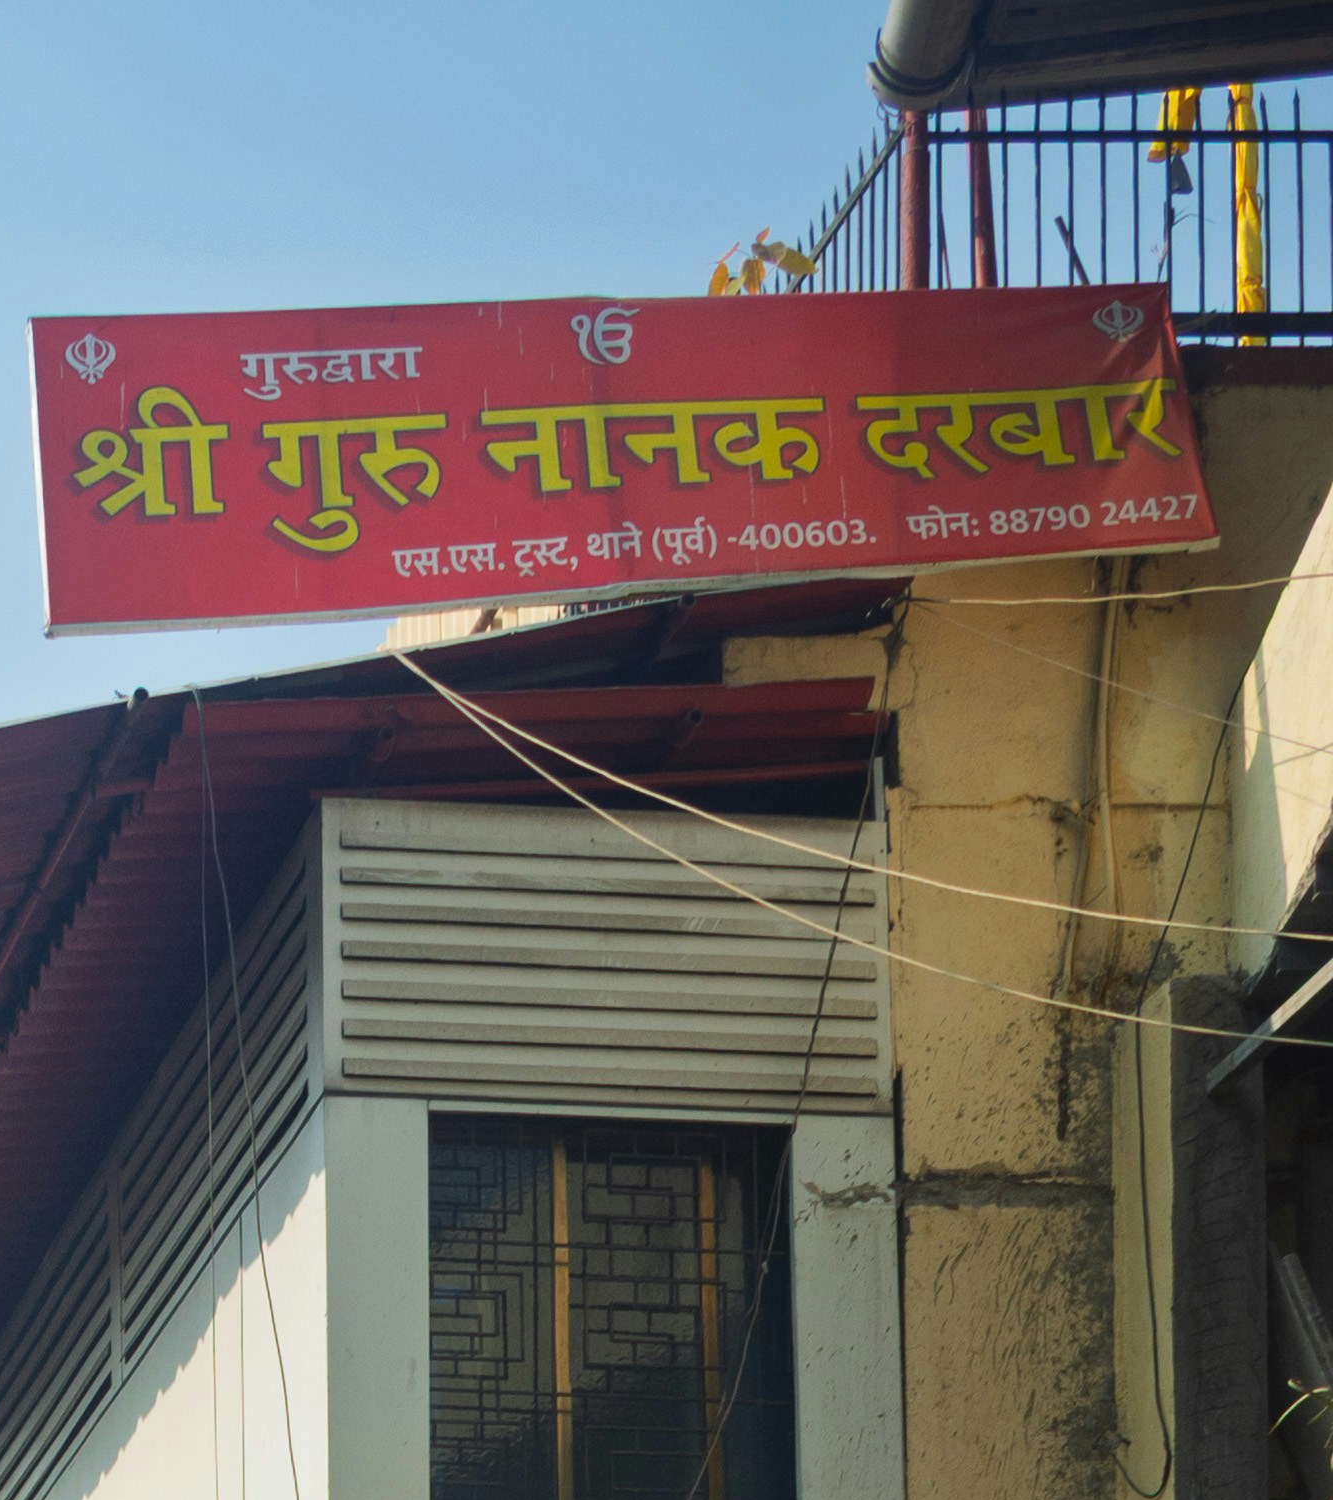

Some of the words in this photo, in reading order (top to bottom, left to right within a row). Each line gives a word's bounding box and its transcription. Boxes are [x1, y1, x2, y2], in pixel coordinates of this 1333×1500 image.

[240, 346, 423, 401] गुरुद्वारा
[74, 386, 229, 517] श्री
[262, 412, 446, 552] गुरु
[481, 397, 824, 491] नानक
[856, 377, 1182, 478] दरबार
[586, 521, 641, 561] थाने
[651, 516, 718, 565] (पूर्व)
[907, 505, 980, 542] फोन:
[989, 502, 1090, 535] 88790
[1099, 493, 1198, 527] 24427
